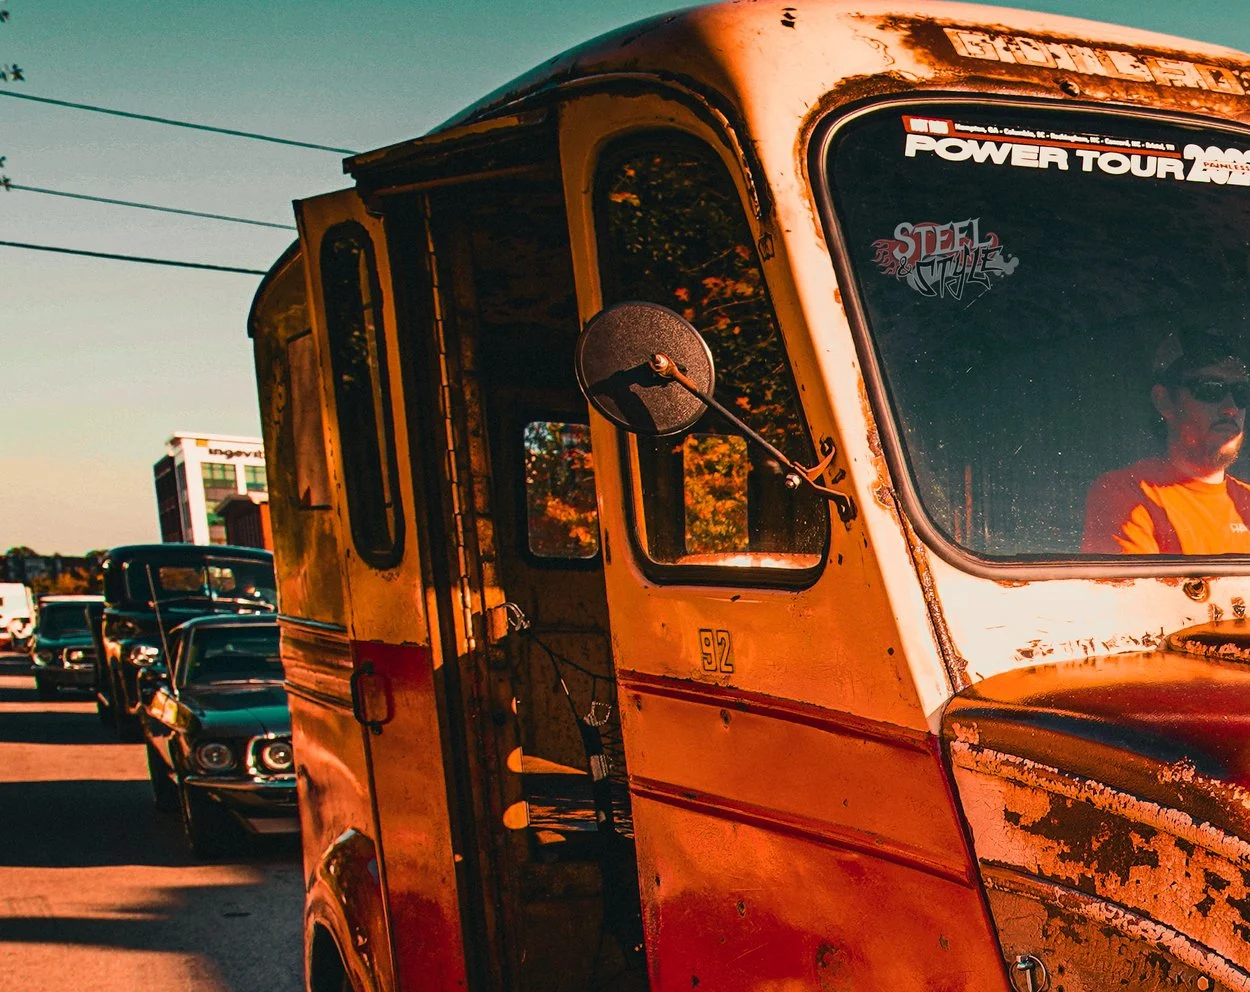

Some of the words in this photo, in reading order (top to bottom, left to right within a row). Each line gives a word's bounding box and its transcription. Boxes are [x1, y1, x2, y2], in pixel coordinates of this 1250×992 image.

[904, 133, 1069, 171] POWER
[1075, 149, 1185, 181] TOUR
[1203, 161, 1250, 172] PAINLESS
[893, 217, 994, 261] STEEL
[699, 628, 734, 674] 92
